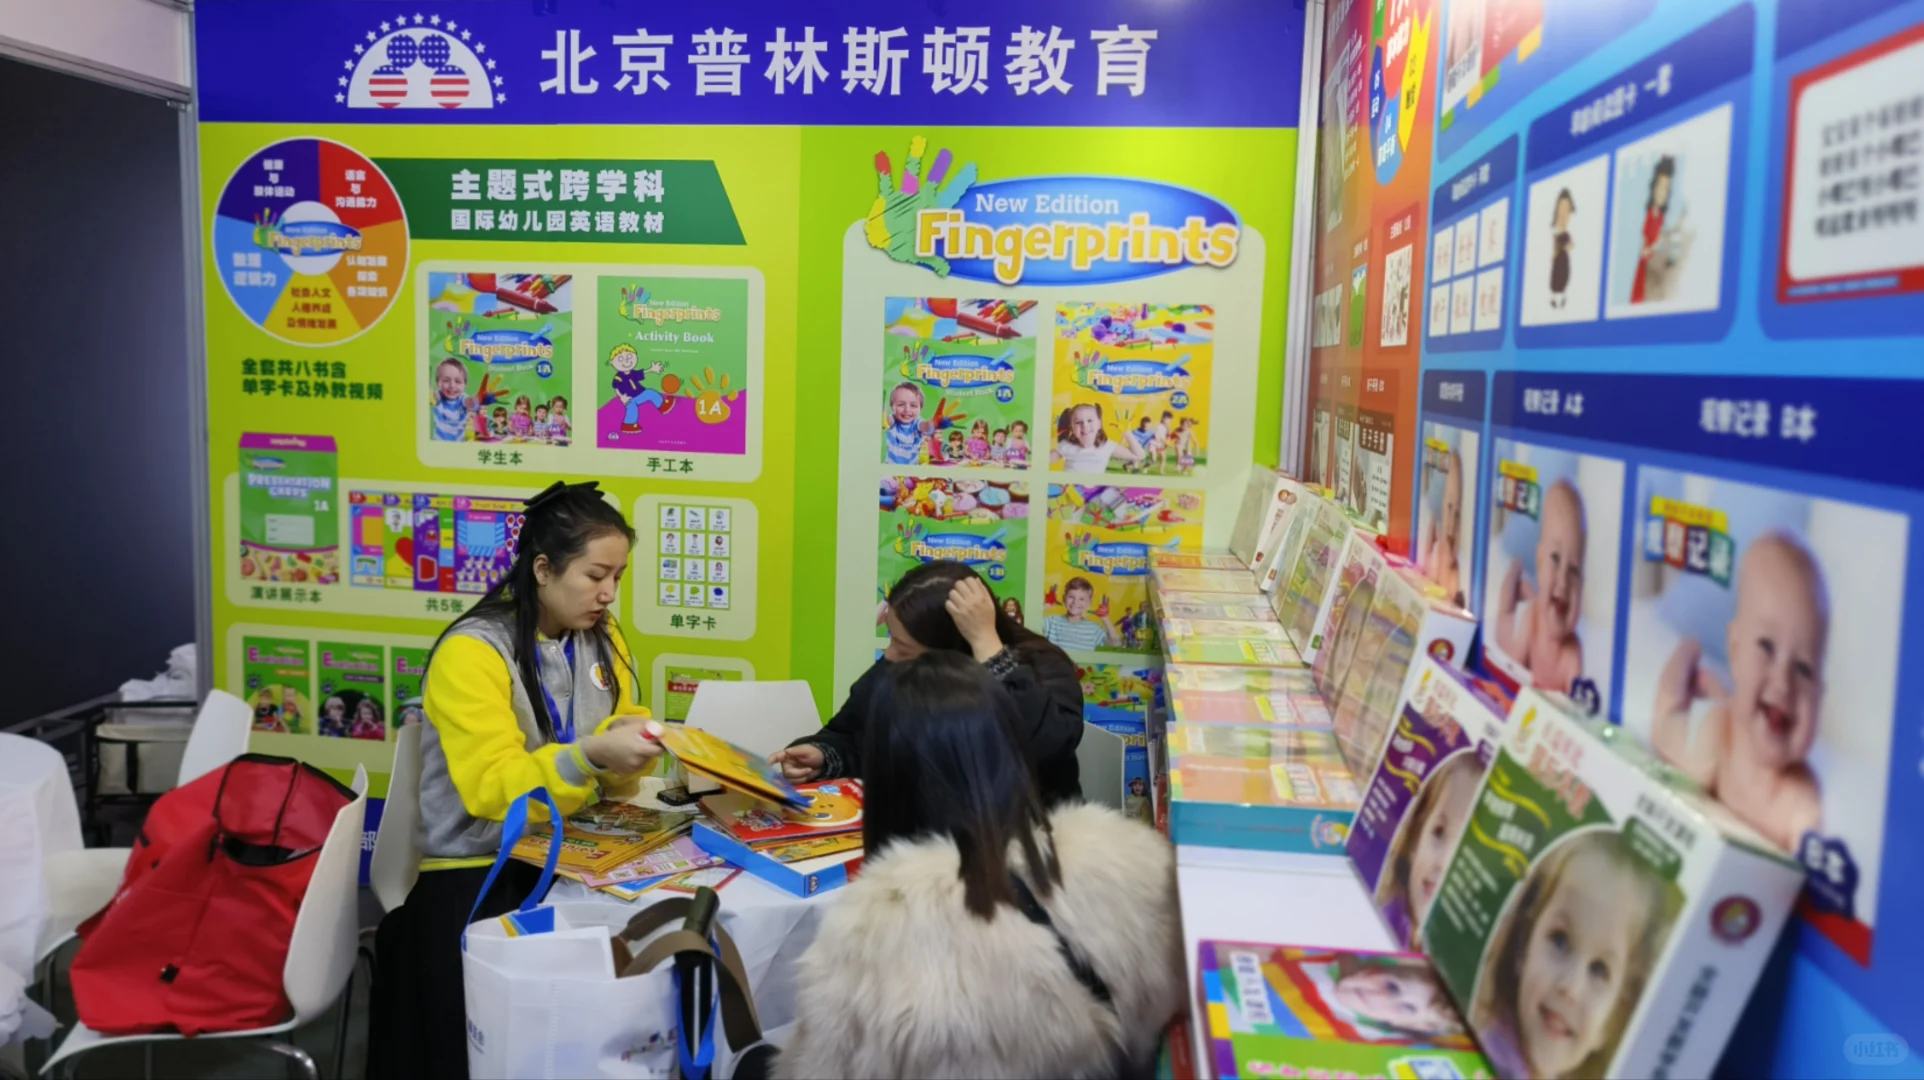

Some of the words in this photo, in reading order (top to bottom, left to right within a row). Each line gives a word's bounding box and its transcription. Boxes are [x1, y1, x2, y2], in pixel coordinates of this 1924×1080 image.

[539, 24, 1158, 97] 北京普林斯顿教育
[451, 168, 664, 203] 主题式跨学科
[975, 193, 1029, 213] New
[1036, 194, 1119, 215] Edition
[451, 209, 664, 235] 国际幼儿园英语教材
[268, 232, 362, 255] Fingerprints
[917, 209, 1239, 284] Fingerprints
[291, 287, 331, 299] 社会人文
[633, 304, 720, 326] Fingerprints
[635, 331, 679, 345] Activity
[683, 332, 714, 343] Book
[460, 339, 553, 362] Fingerprints
[241, 358, 347, 379] 全套共八书含
[537, 364, 551, 373] 1A
[917, 364, 1015, 387] Fingerprints
[1126, 365, 1152, 373] Edition
[242, 379, 384, 400] 单字卡及外教视频
[1088, 369, 1191, 393] Fingerprints
[997, 389, 1012, 397] 1A
[1172, 395, 1188, 404] 2A
[699, 399, 722, 415] 1A
[478, 450, 523, 467] 学生本
[646, 457, 694, 474] 手工本
[247, 473, 332, 490] PRESENTATION
[314, 500, 329, 511] 1A
[911, 541, 1007, 561] Fingerprints
[1079, 551, 1148, 576] Fingerpr
[250, 586, 322, 603] 演讲展示本
[425, 597, 464, 612] 共5张
[670, 614, 716, 630] 单字卡
[1109, 724, 1136, 734] Edition
